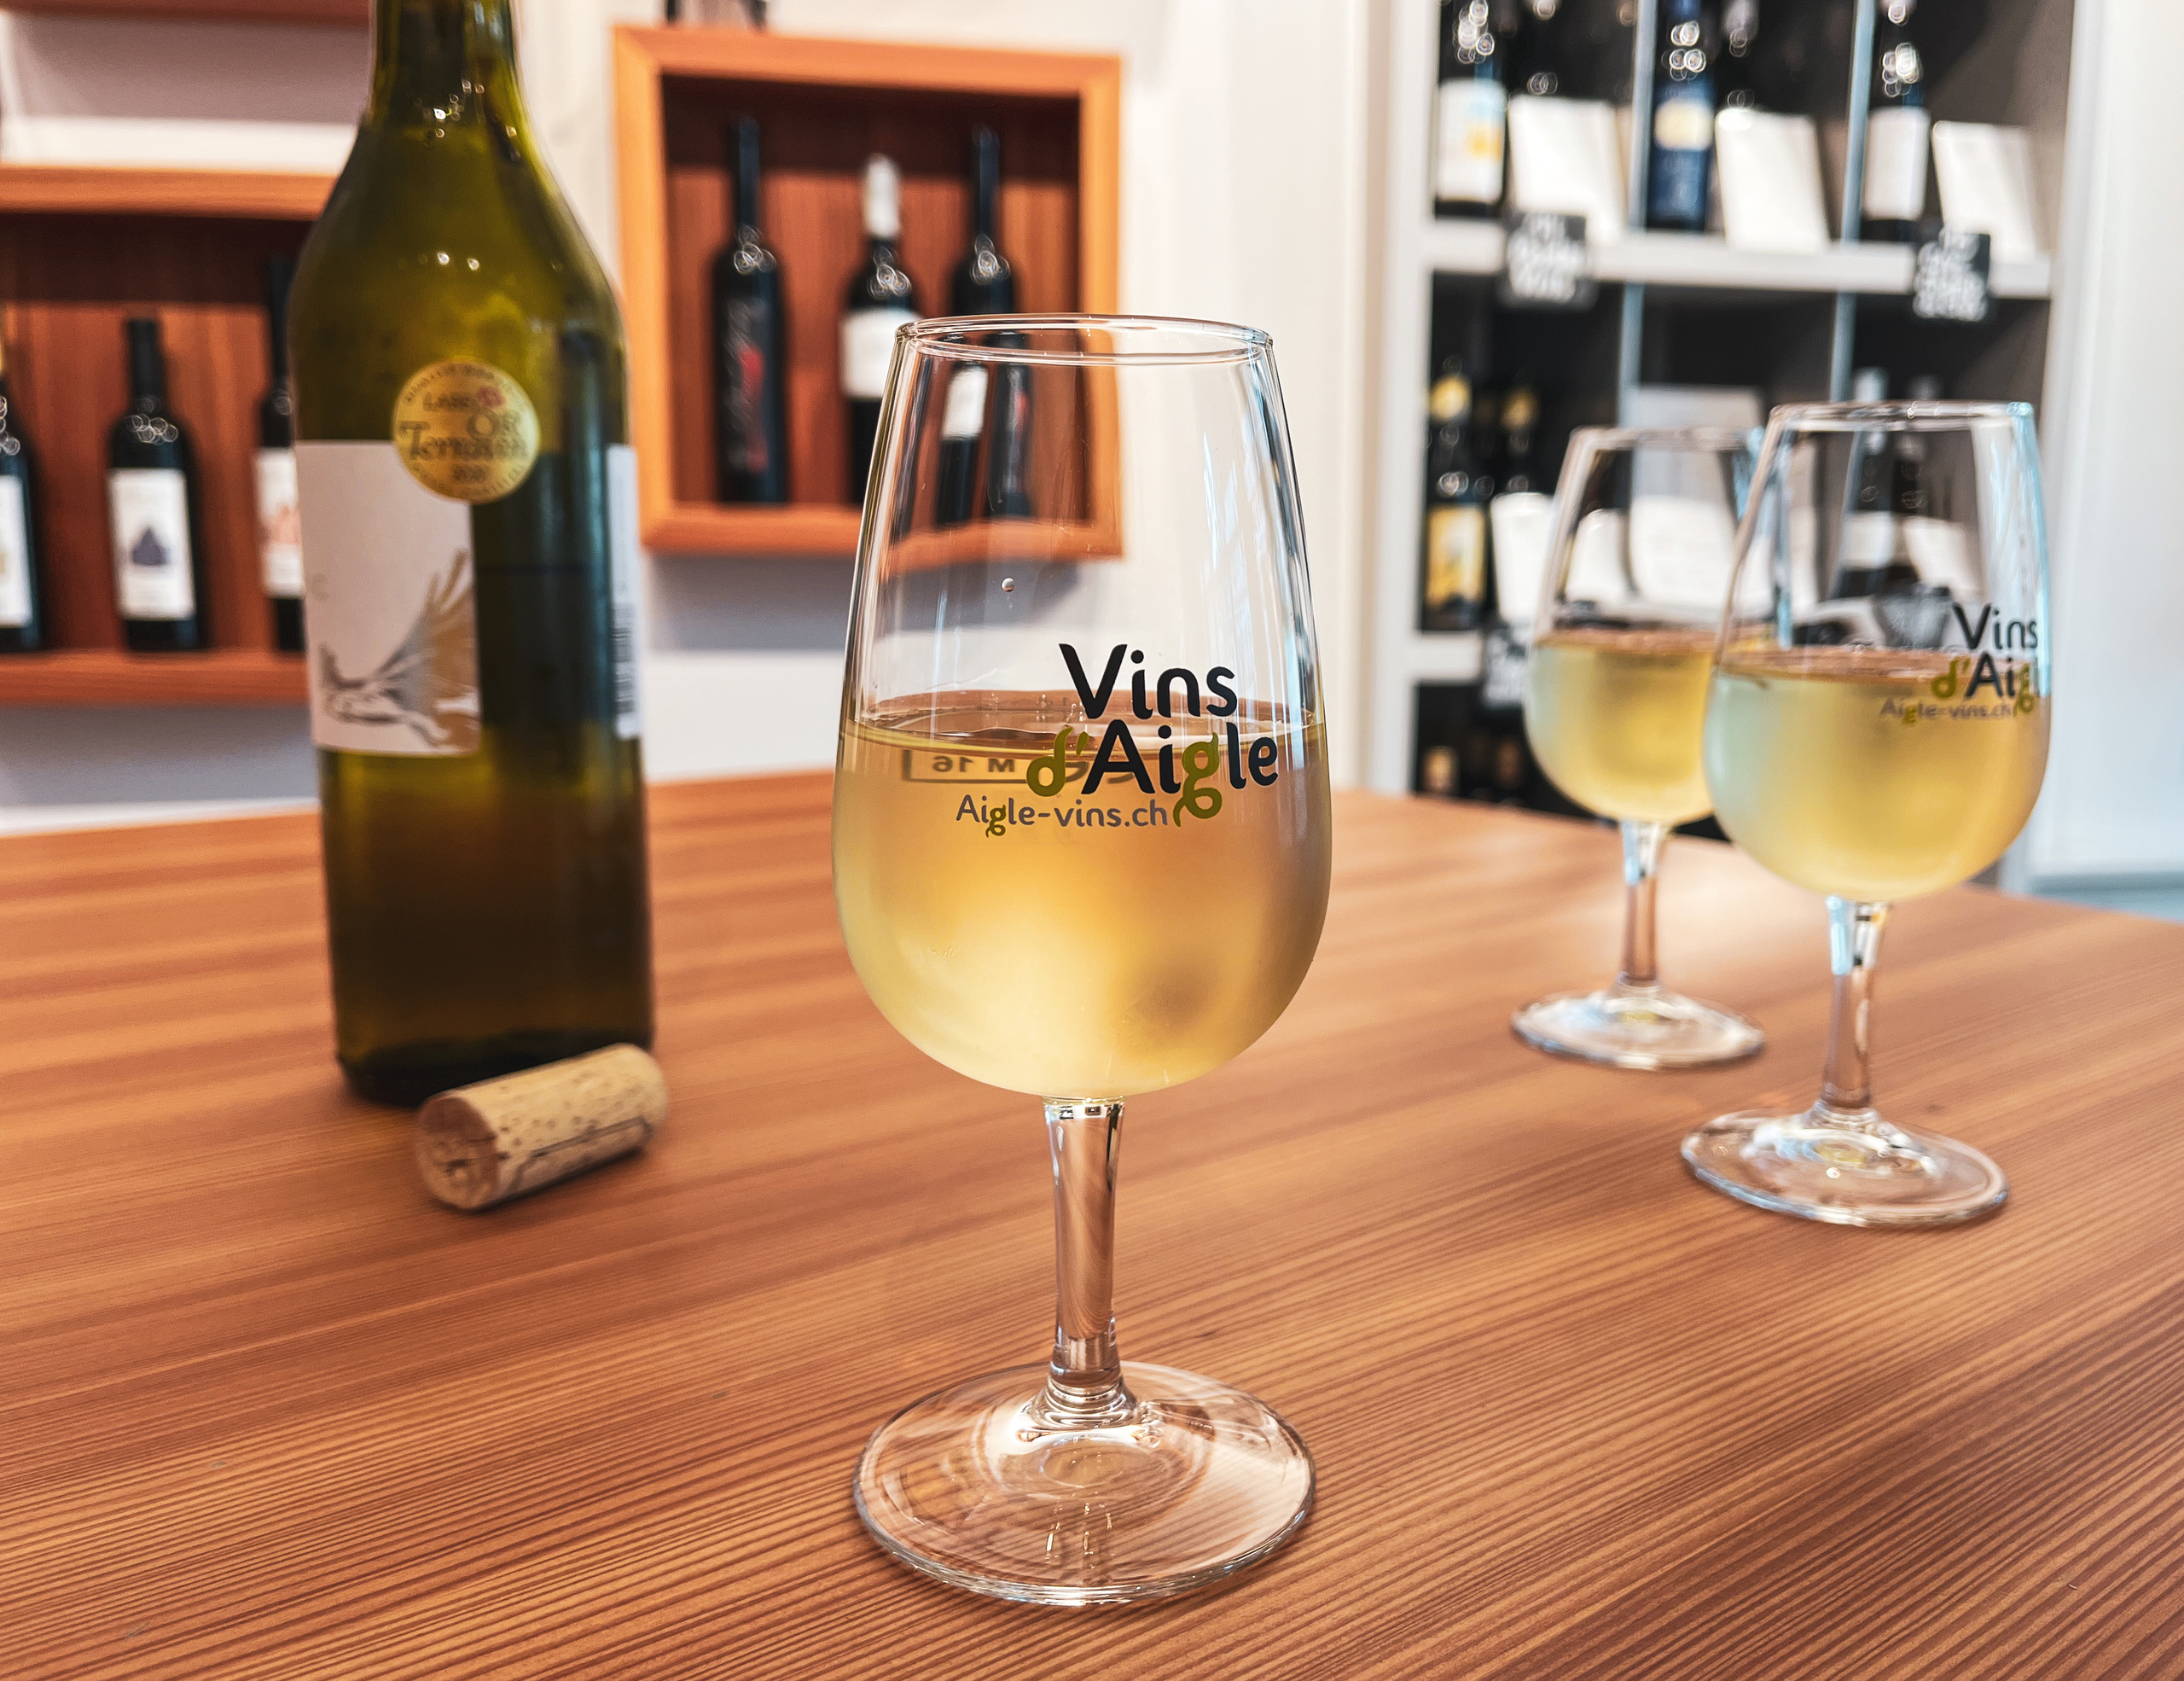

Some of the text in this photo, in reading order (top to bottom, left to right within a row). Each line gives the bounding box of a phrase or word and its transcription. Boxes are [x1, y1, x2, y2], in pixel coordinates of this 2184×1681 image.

[1952, 602, 2037, 649] Vins
[1059, 643, 1237, 719] Vins
[1879, 697, 2012, 725] Aigle-vins.ch
[1026, 719, 1279, 827] d'Aigle
[956, 794, 1168, 838] Aigle-vins.ch
